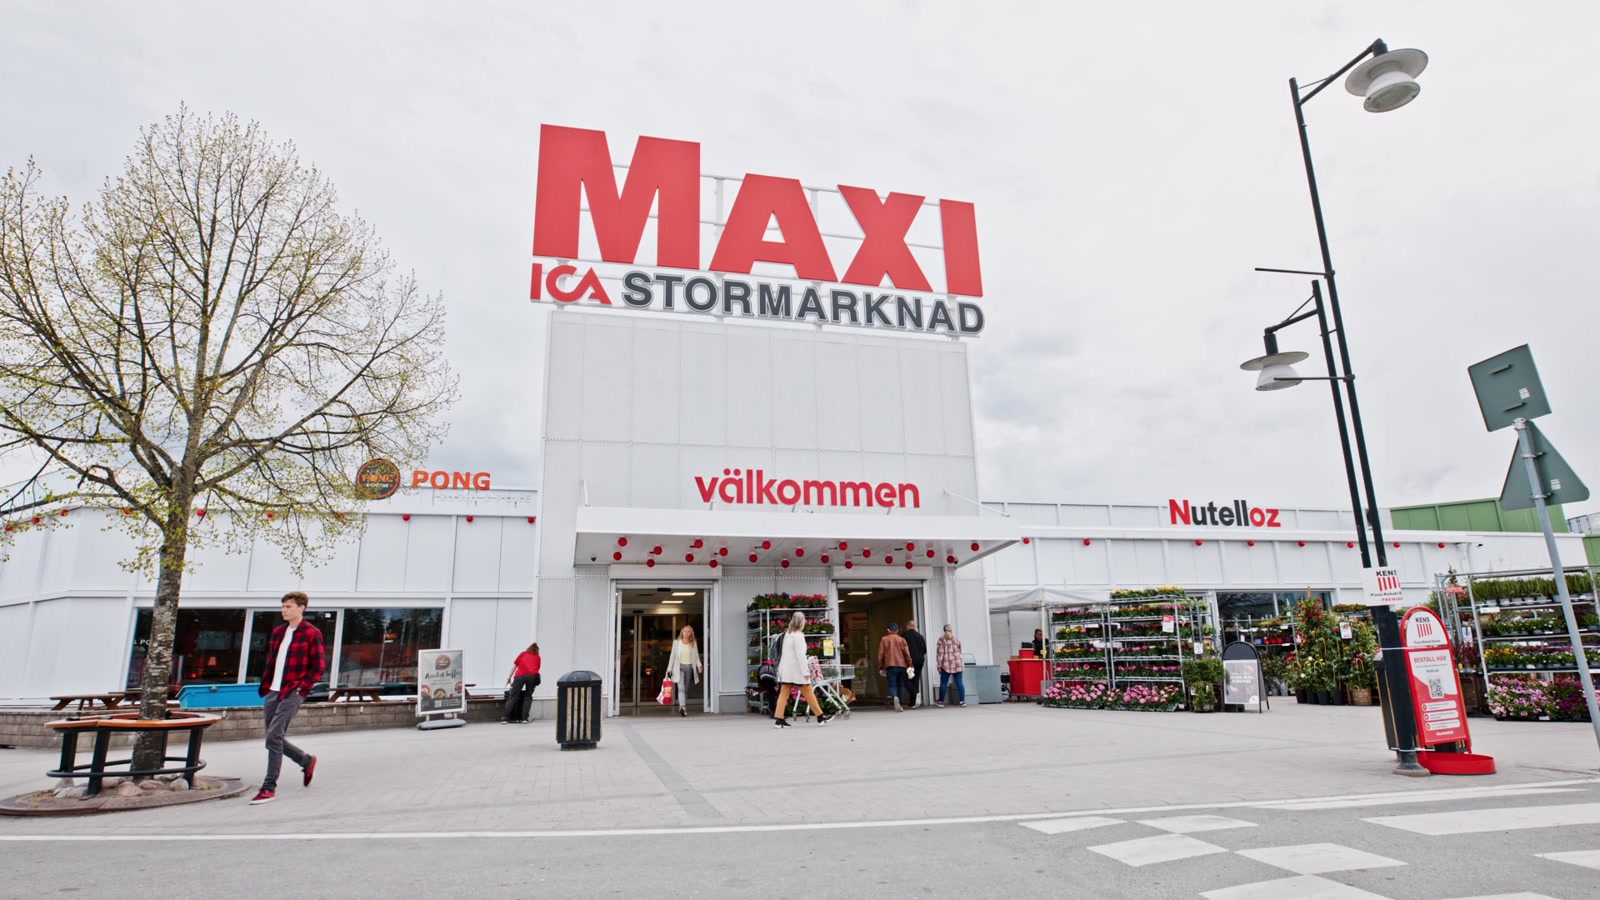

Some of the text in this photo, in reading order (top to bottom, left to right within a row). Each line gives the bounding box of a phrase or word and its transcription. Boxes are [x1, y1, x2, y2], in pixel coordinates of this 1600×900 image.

[532, 123, 983, 297] MAXI
[530, 263, 985, 335] ICA STORMARKNAD
[412, 470, 491, 490] PONG
[694, 468, 920, 508] välkommen
[1168, 499, 1281, 528] Nutelloz
